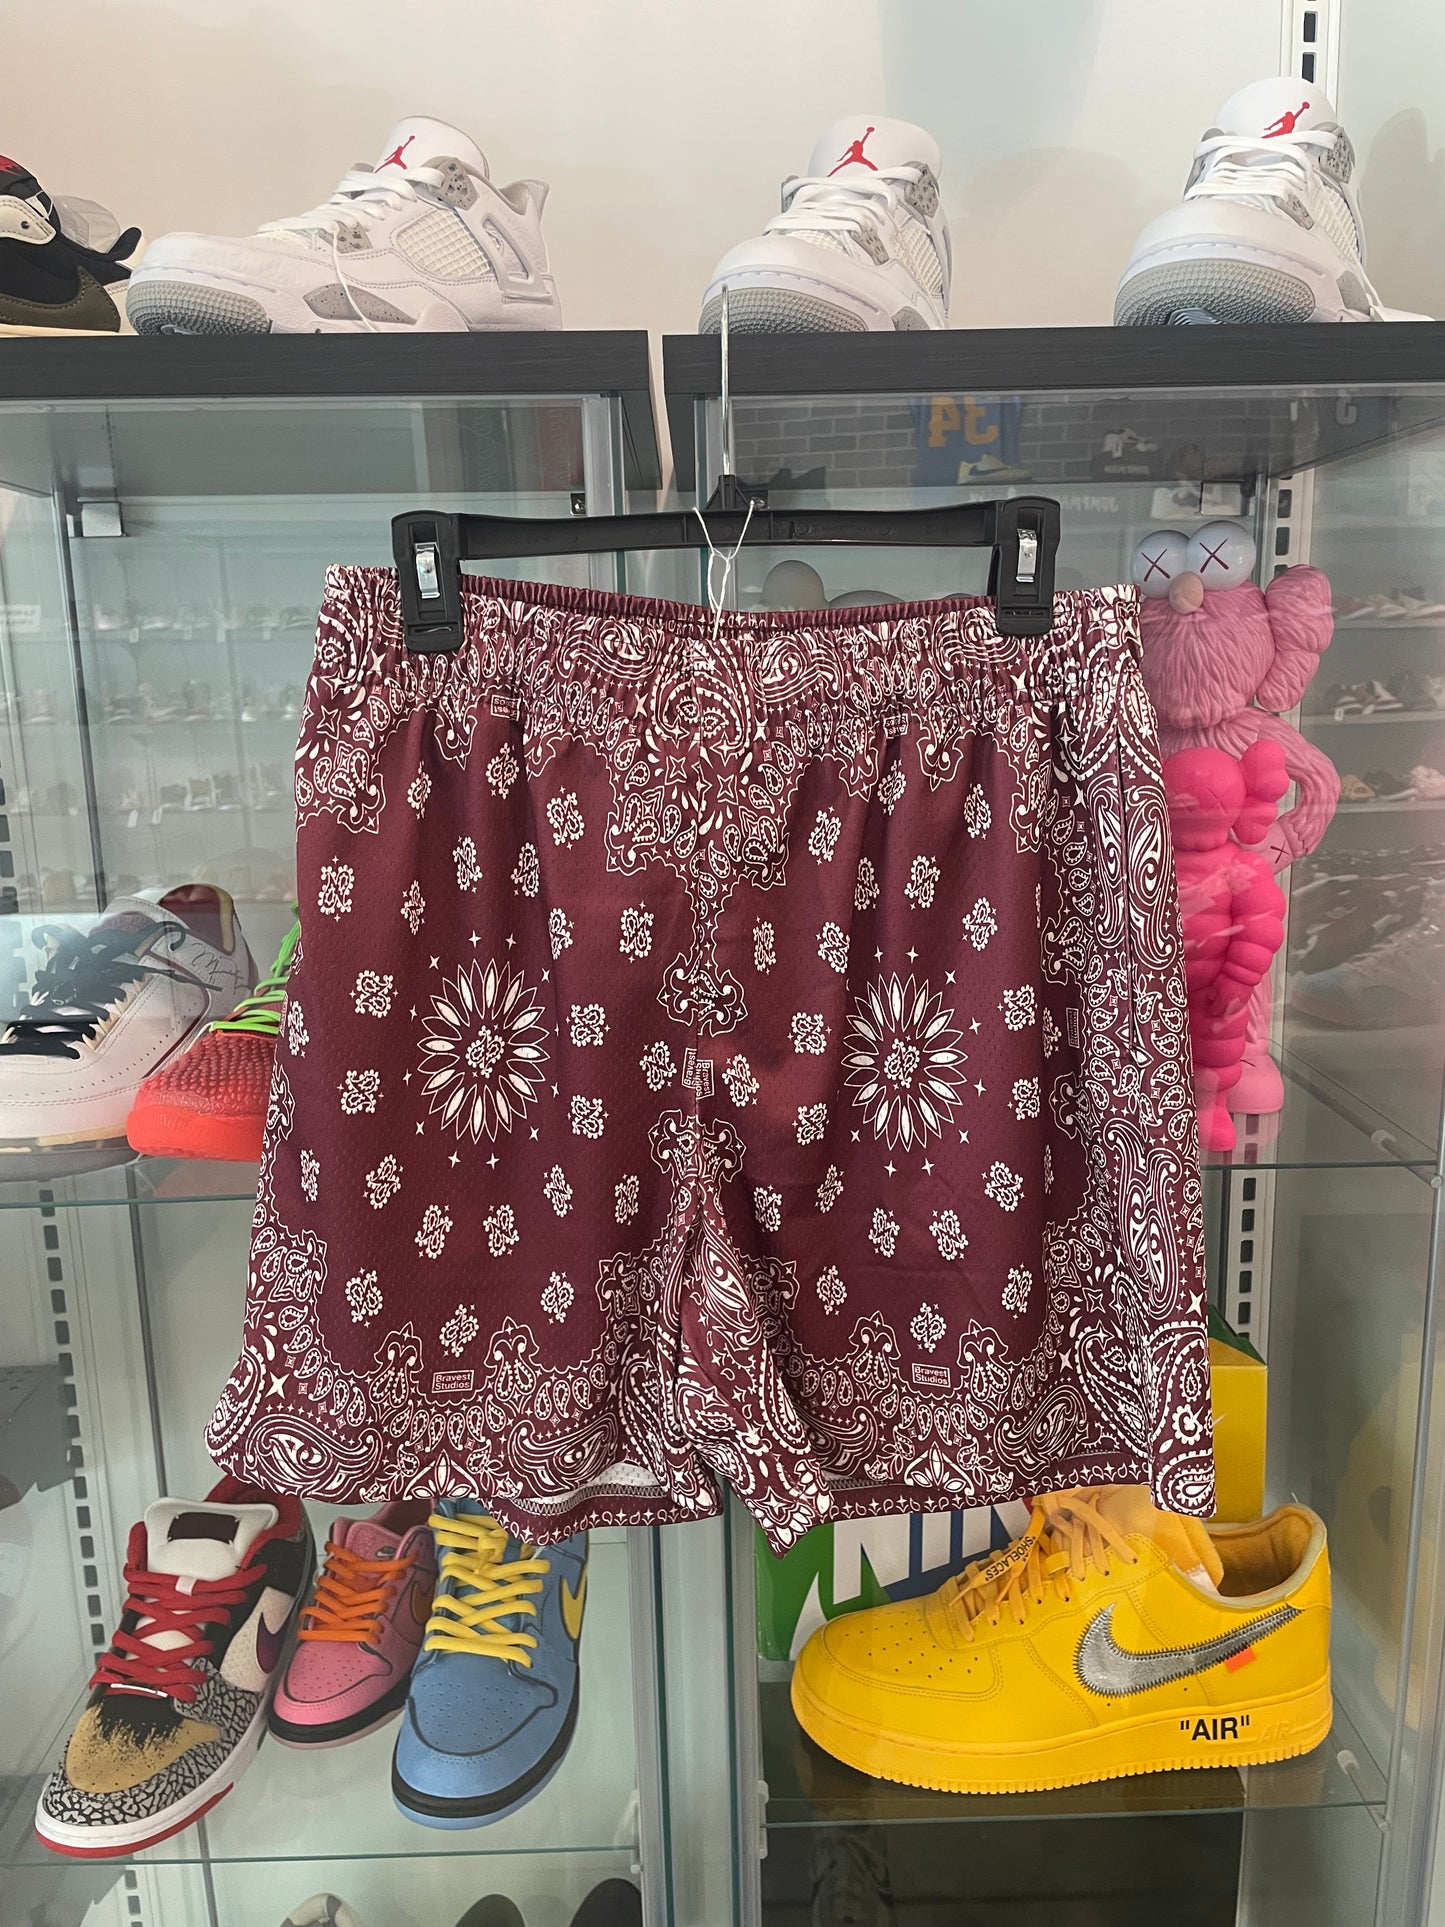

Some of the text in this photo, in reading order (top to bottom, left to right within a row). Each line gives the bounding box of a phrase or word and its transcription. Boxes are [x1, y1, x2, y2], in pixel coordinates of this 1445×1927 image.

[702, 1063, 711, 1095] Bravest
[915, 1366, 948, 1377] Bravest
[435, 1373, 471, 1382] Bravest
[916, 1374, 948, 1385] Studios
[434, 1381, 470, 1390] Studios
[1180, 1714, 1250, 1741] "AIR"
